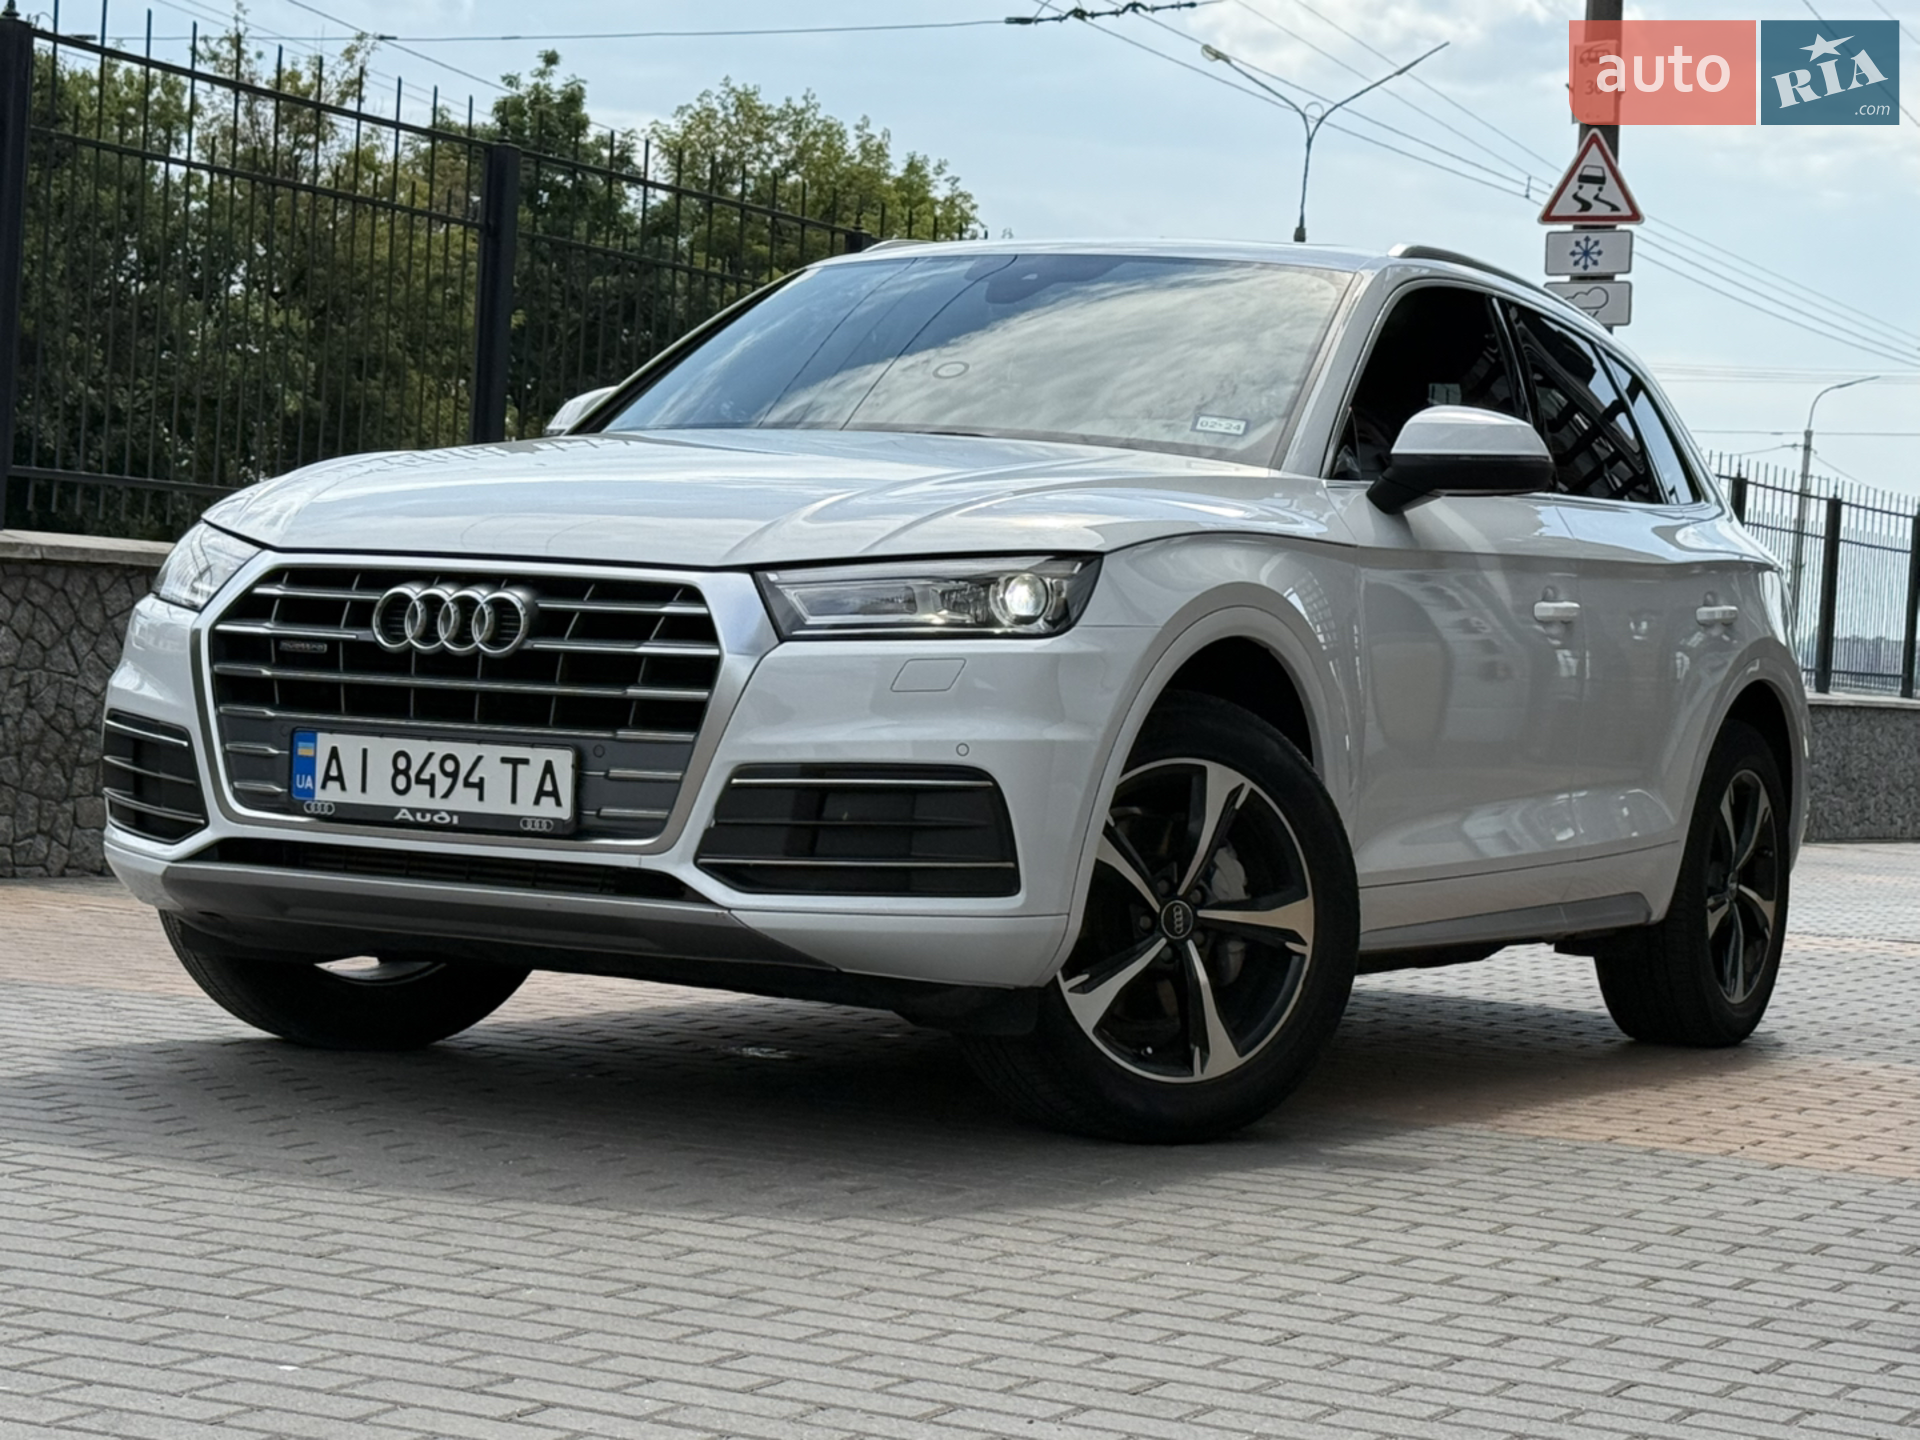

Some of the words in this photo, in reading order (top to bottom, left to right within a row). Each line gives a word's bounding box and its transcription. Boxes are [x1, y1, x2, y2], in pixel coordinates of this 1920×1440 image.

[296, 774, 313, 790] UA
[320, 746, 368, 793] AI
[391, 750, 485, 802] 8494
[500, 756, 562, 807] TA
[394, 808, 459, 825] Audi
